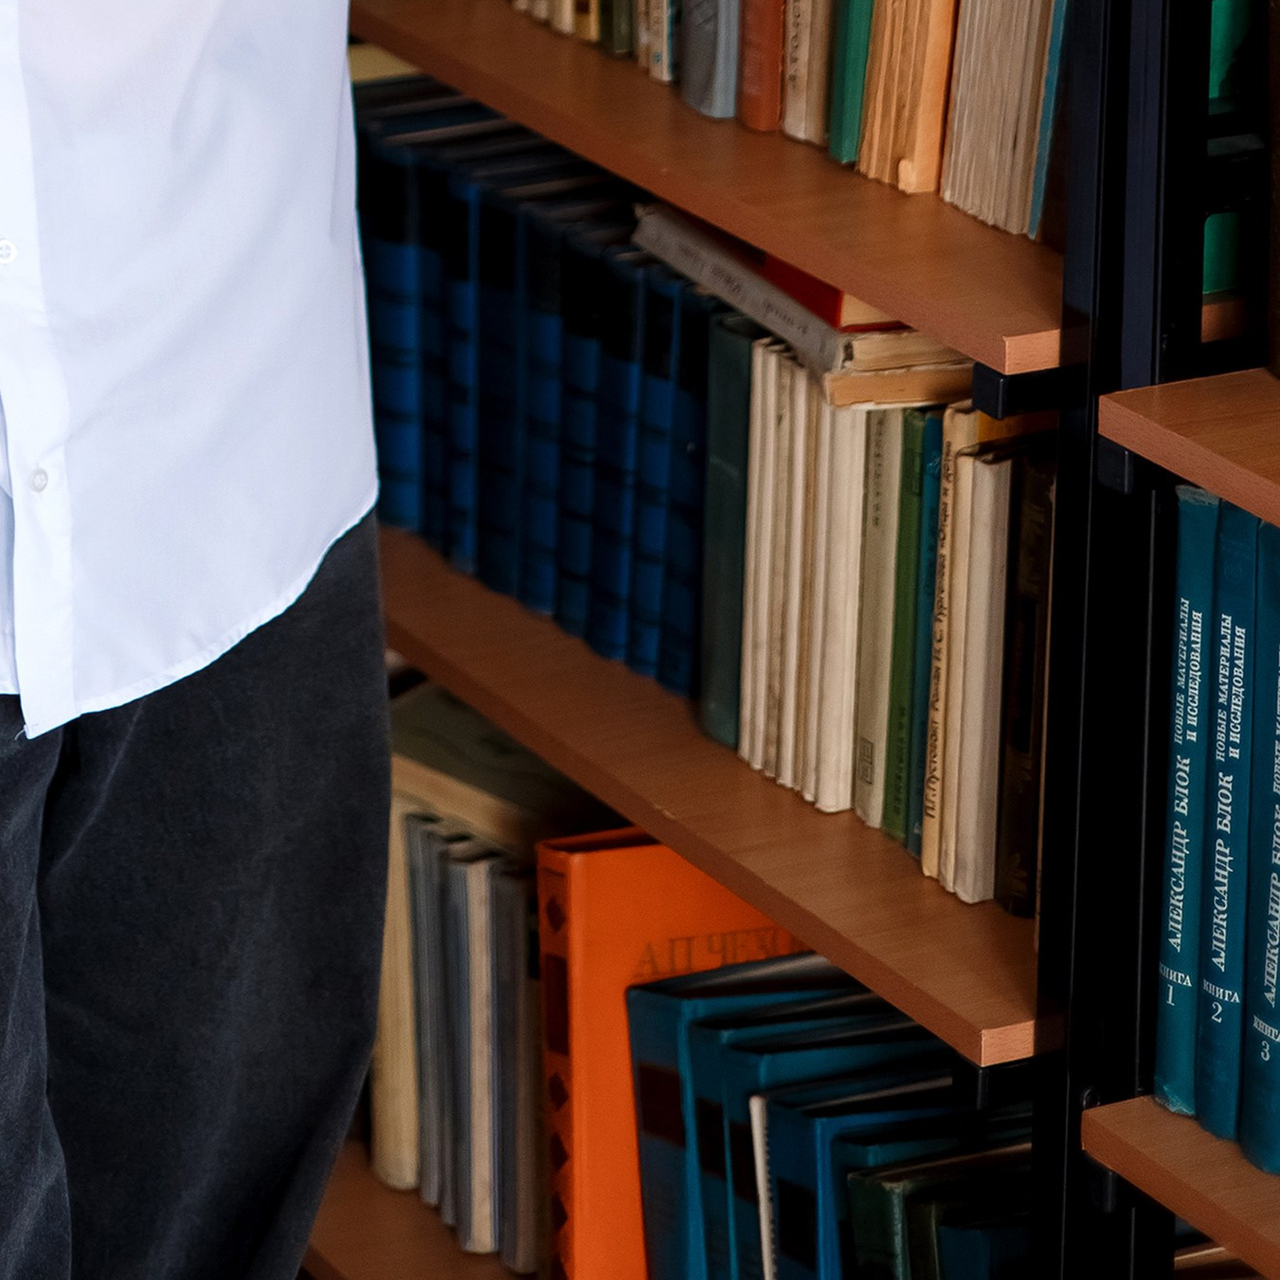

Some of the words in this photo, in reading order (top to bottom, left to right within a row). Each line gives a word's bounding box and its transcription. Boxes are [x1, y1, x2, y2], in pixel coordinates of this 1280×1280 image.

[1176, 597, 1190, 689] МАТЕРИАЛЫ
[1187, 610, 1203, 727] ИССЛЕДОВАНИЯ
[1218, 612, 1233, 704] МАТЕРИАЛЫ
[1229, 625, 1248, 744] ИССЛЕДОВАНИЯ
[1173, 692, 1185, 745] НОВЫЕ
[1187, 730, 1197, 743] И
[1216, 706, 1227, 762] НОВЫЕ
[1228, 747, 1239, 760] И
[1173, 754, 1191, 816] БЛОК
[1217, 771, 1235, 835] БЛОК
[1167, 821, 1190, 953] АЛЕКСАНДР
[1211, 839, 1232, 972] АЛЕКСАНДР
[1263, 872, 1280, 1008] АЛЕКСАНДР
[1166, 984, 1175, 1006] 1
[1203, 979, 1240, 1004] КНИГА
[1211, 1001, 1223, 1024] 2
[1260, 1040, 1270, 1061] 3
